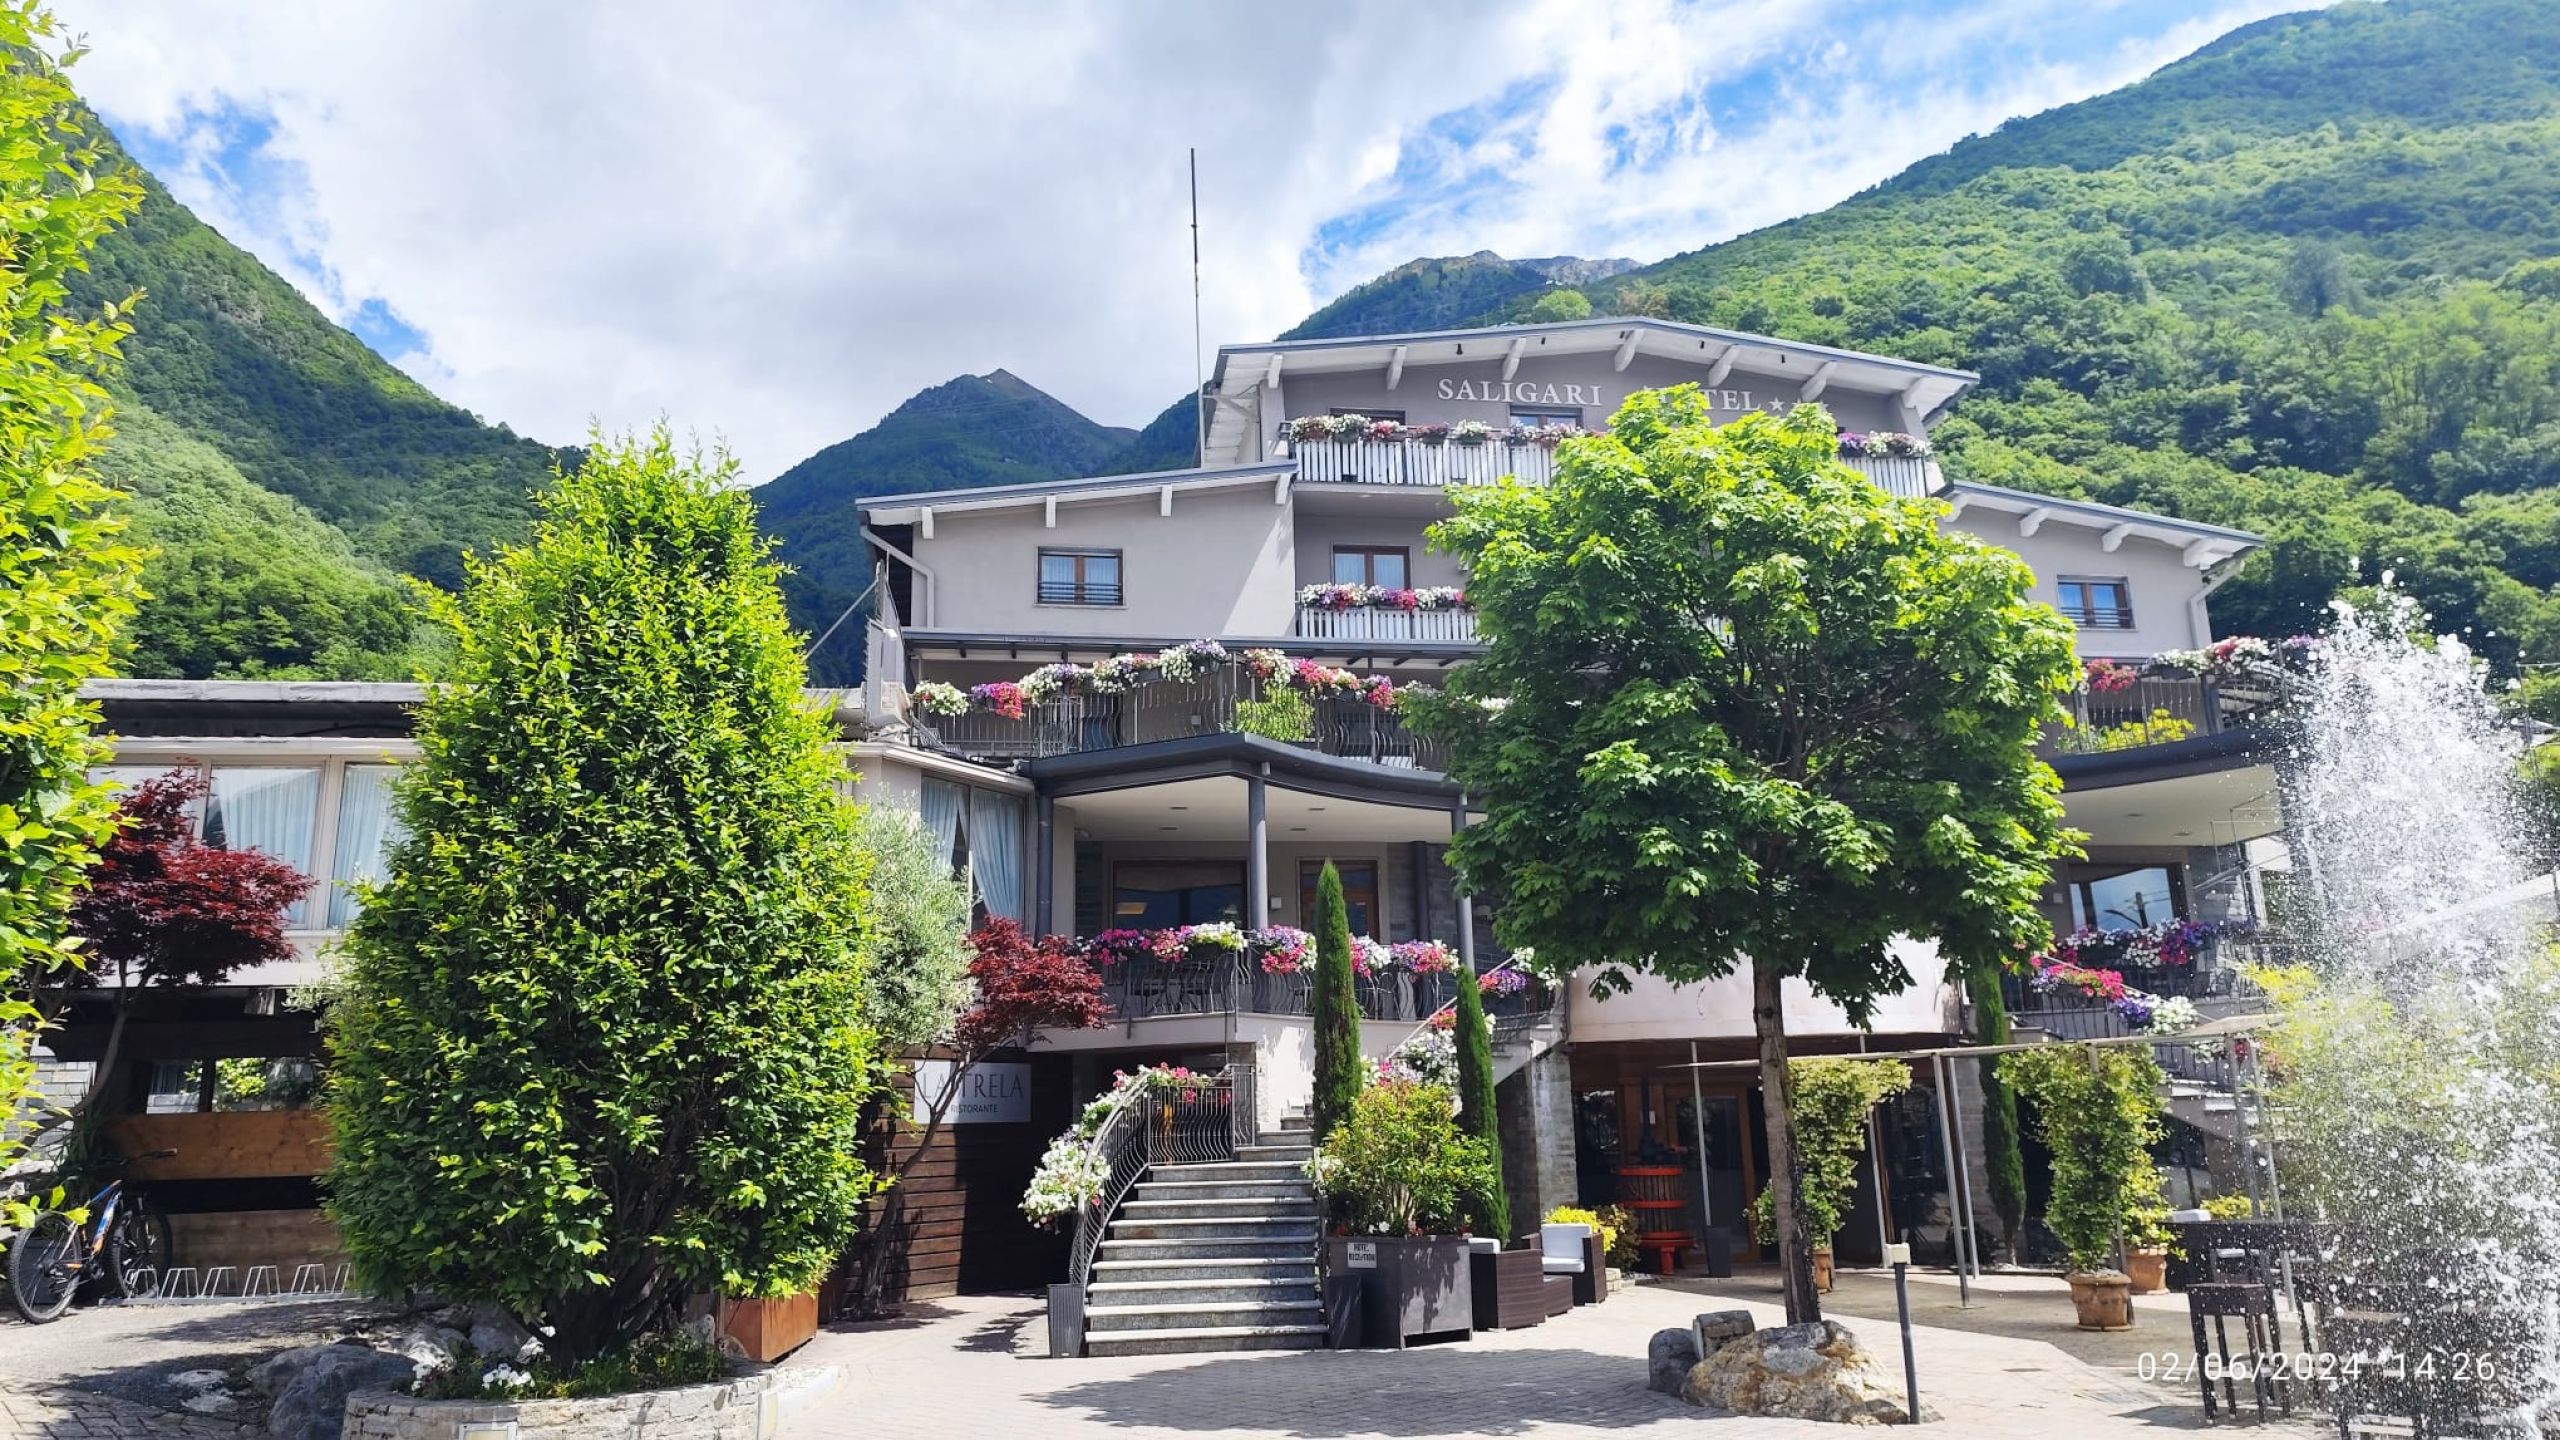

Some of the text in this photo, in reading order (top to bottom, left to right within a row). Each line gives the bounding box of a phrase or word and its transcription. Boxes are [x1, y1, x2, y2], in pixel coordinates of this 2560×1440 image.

[1438, 378, 1762, 412] SALIGARI TEL
[951, 1104, 998, 1113] RISTORANTE
